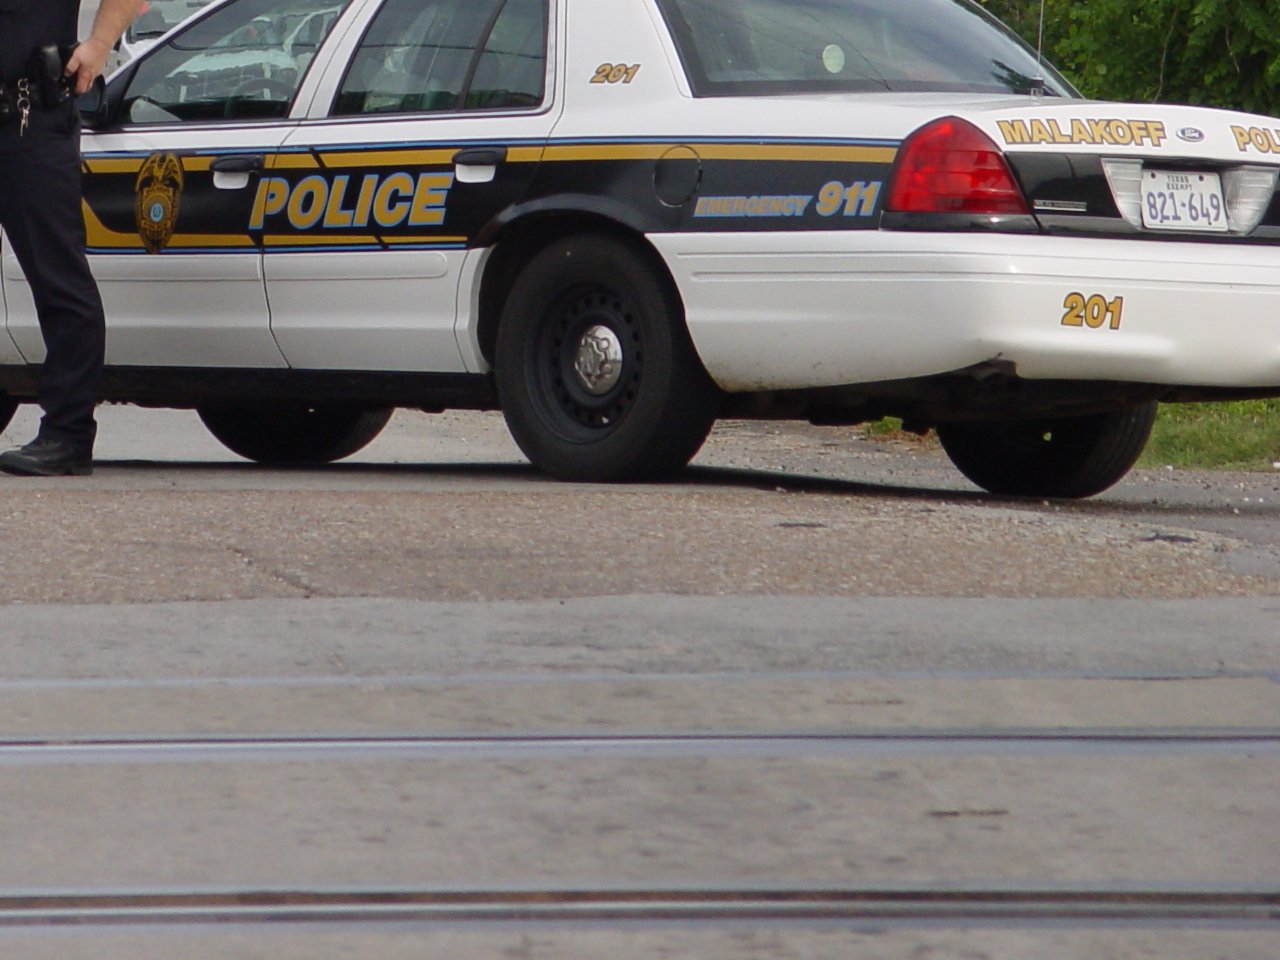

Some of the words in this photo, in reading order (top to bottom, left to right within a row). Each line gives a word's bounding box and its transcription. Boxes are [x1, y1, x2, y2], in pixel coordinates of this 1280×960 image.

[589, 62, 641, 84] 201
[997, 119, 1167, 147] MALAKOFF
[1229, 125, 1280, 155] POL
[248, 172, 455, 230] POLICE
[693, 195, 814, 217] EMERGENCY
[815, 180, 882, 216] 911
[1061, 292, 1123, 330] 201
